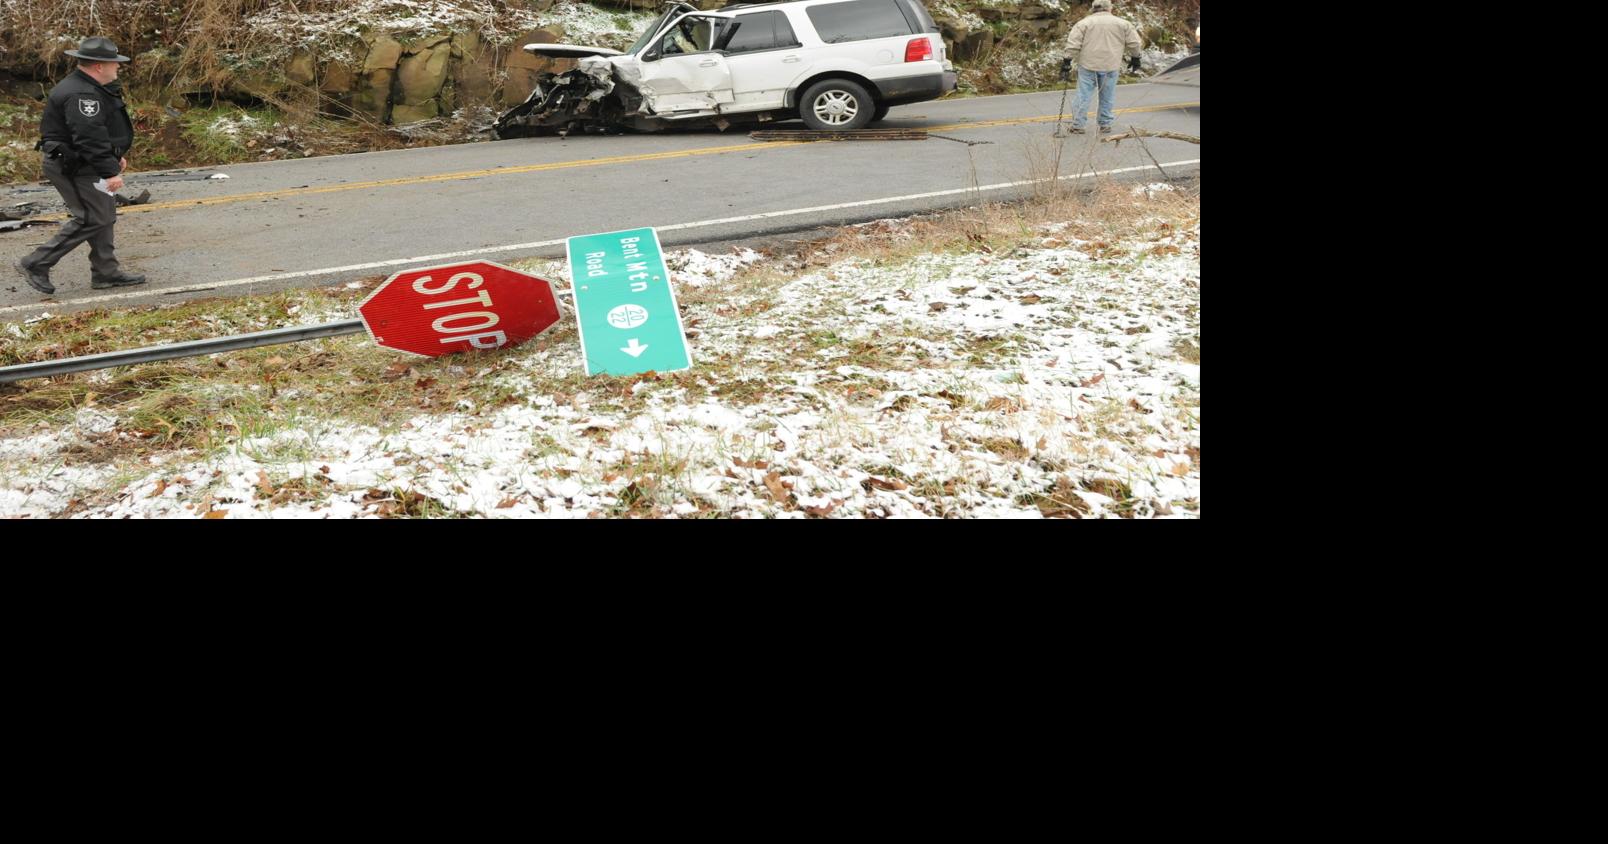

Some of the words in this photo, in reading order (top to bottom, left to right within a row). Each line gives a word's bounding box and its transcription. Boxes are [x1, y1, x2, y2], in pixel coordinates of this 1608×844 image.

[620, 236, 644, 260] Bent
[585, 251, 608, 278] Road
[625, 261, 649, 292] Mtn
[411, 271, 508, 350] STOP
[610, 311, 627, 324] 22
[629, 308, 646, 322] 20
